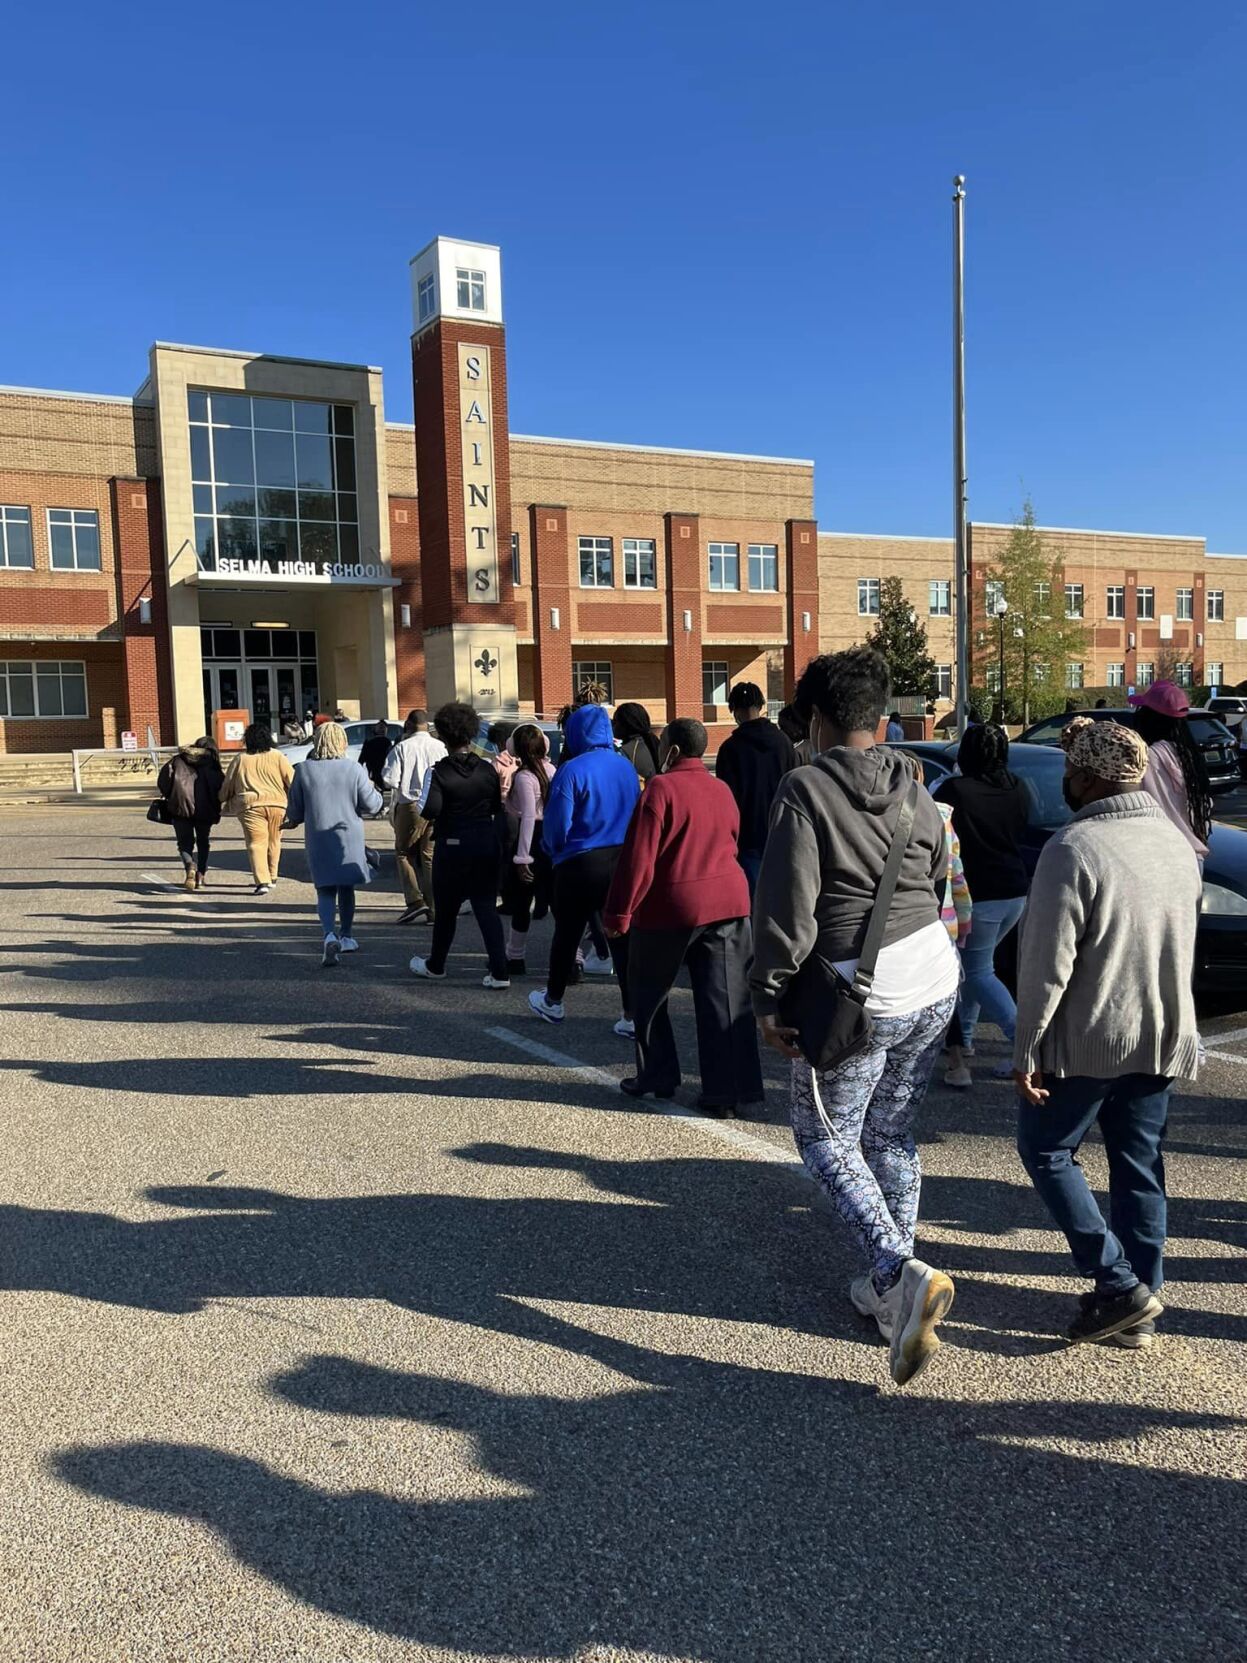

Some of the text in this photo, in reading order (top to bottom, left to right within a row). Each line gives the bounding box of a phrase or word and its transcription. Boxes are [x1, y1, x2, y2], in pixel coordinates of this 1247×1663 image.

[466, 357, 490, 591] SAINTS
[219, 557, 384, 578] SELMA HIGH SCHOOL
